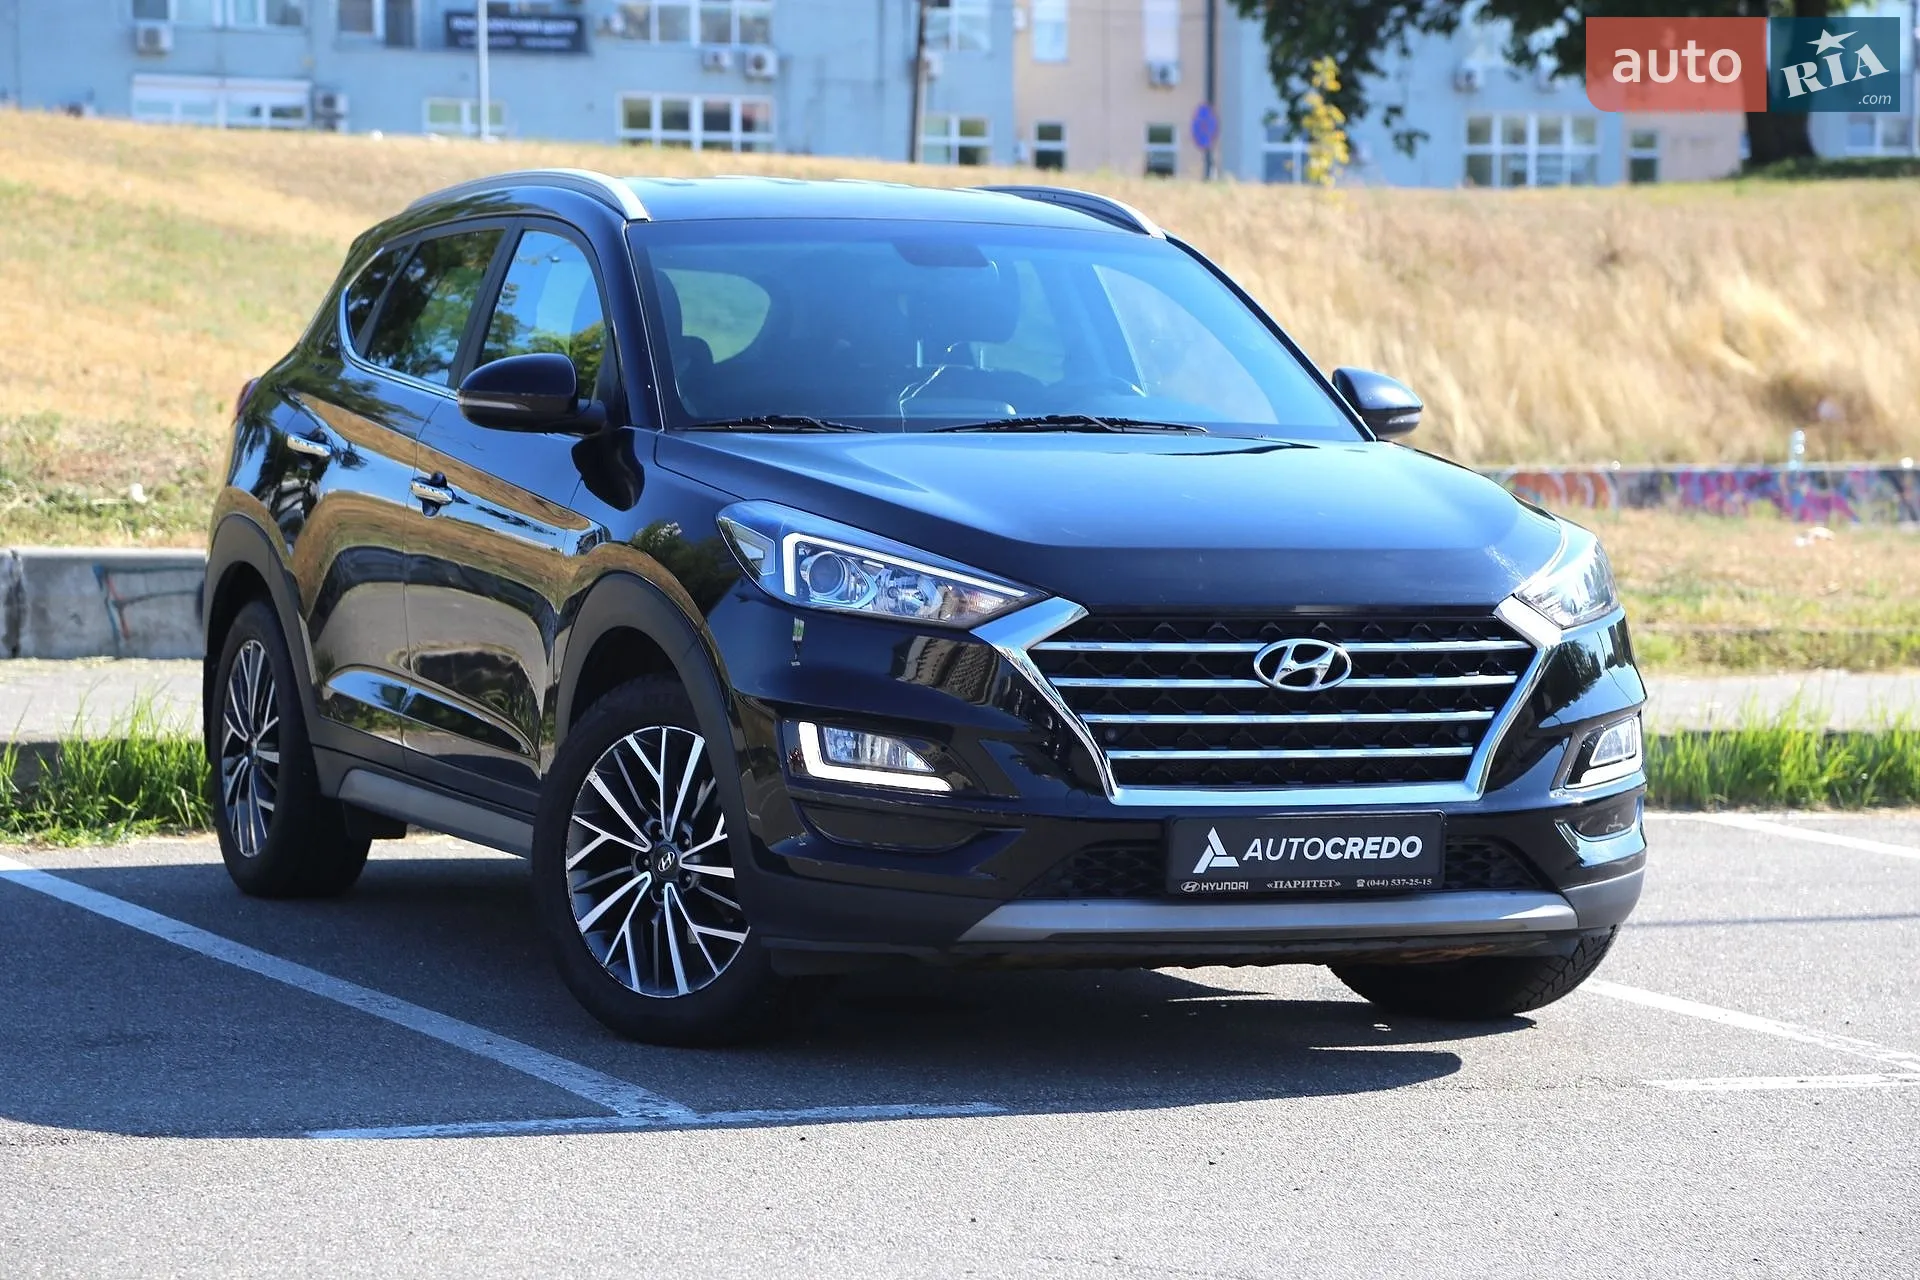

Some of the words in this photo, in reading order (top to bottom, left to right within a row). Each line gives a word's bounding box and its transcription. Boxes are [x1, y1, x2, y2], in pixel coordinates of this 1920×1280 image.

[1242, 835, 1423, 861] AUTOCREDO
[1201, 881, 1249, 891] HYUNDAI
[1366, 879, 1389, 888] (044)
[1390, 878, 1433, 886] 537-25-15
